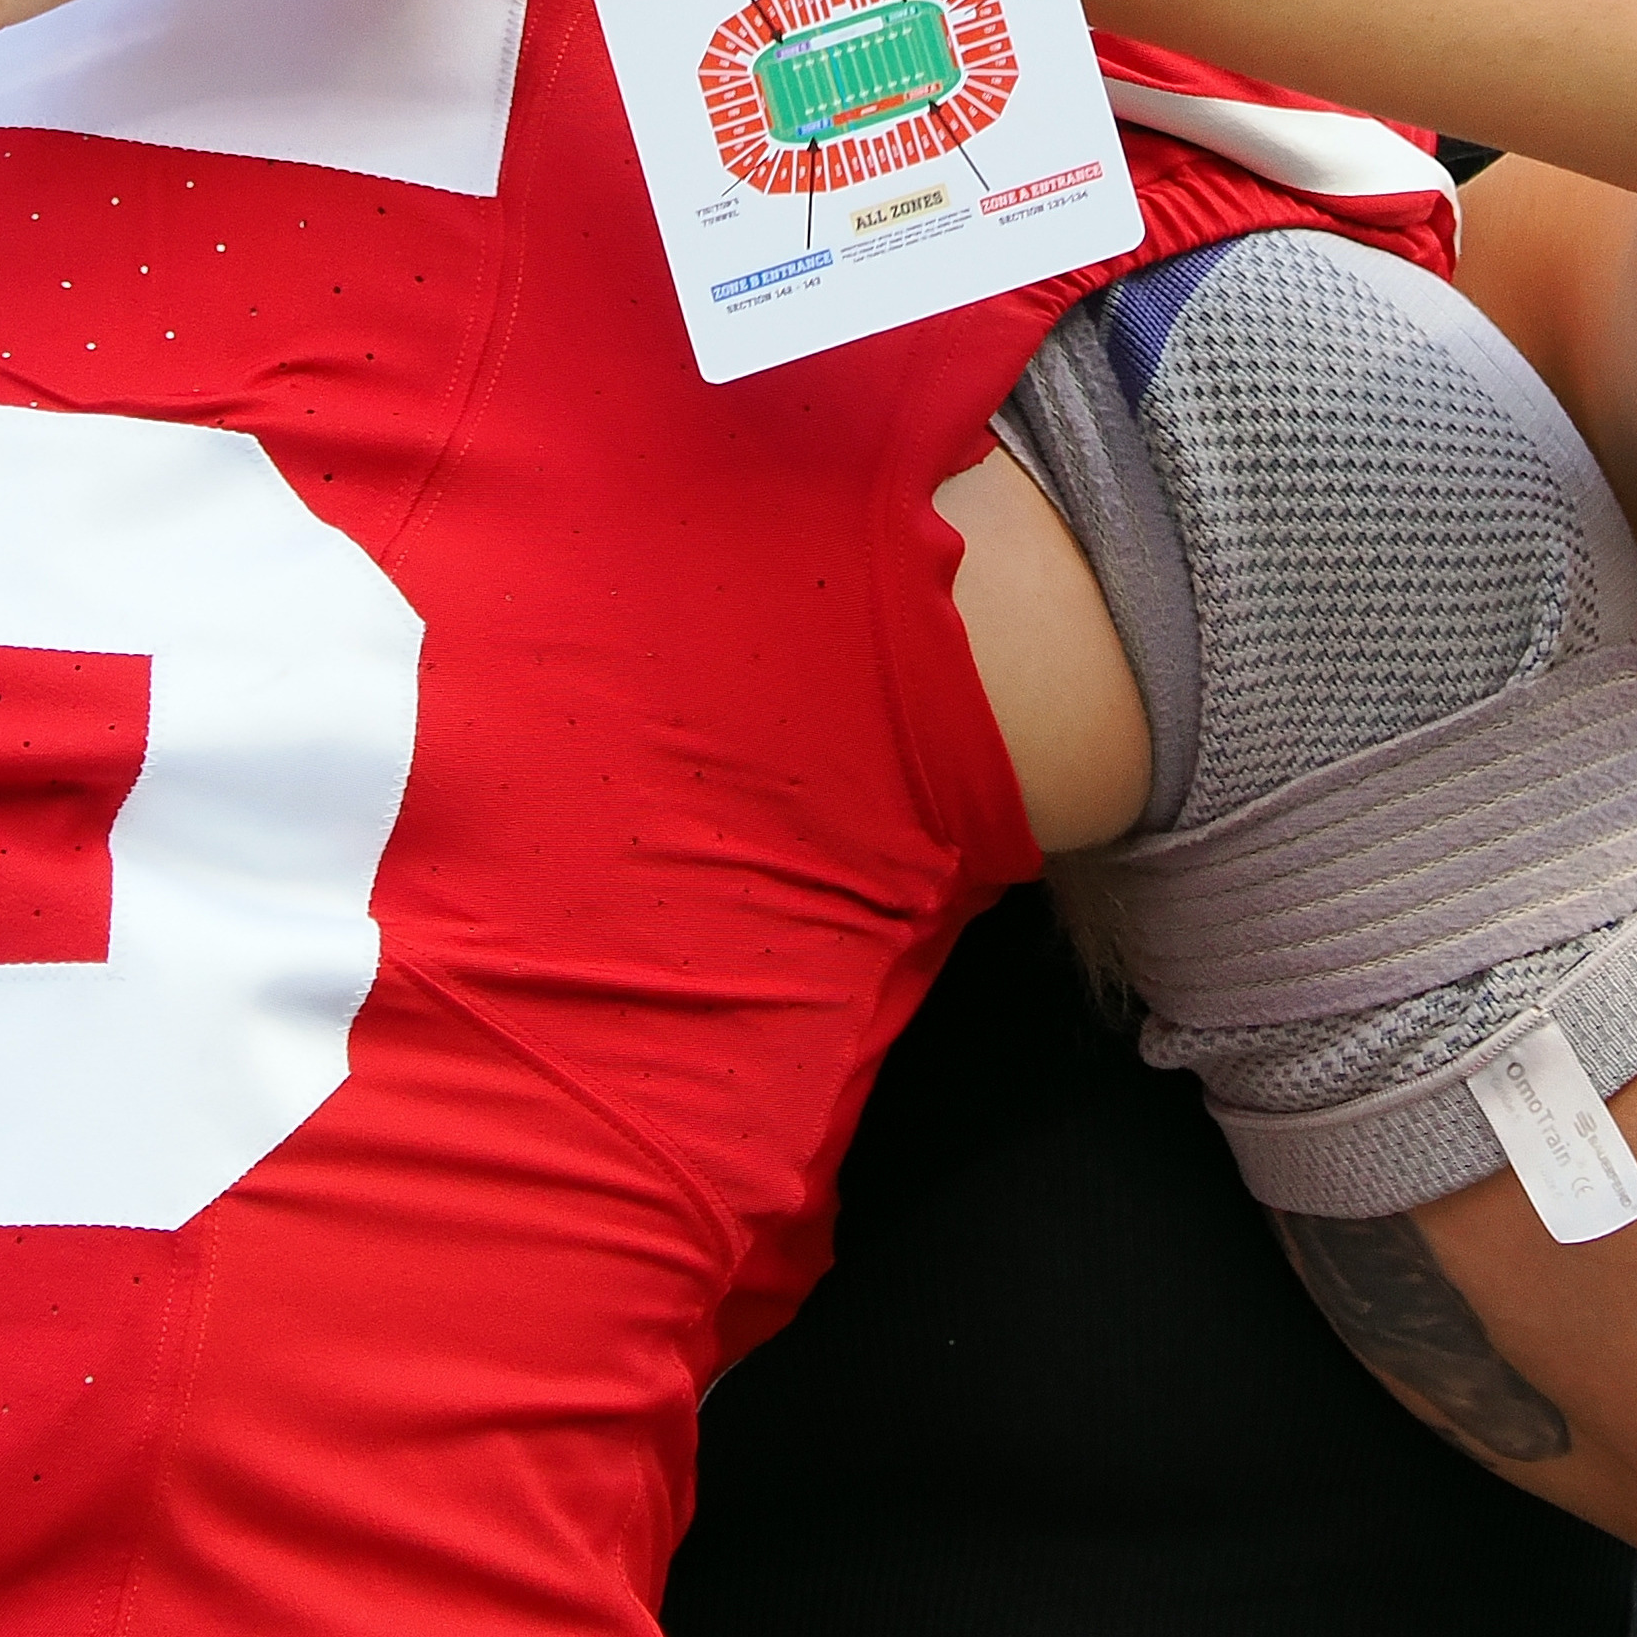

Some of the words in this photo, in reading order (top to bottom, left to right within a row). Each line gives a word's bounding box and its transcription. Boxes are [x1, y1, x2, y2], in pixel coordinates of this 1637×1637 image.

[855, 211, 887, 231] ALL
[890, 190, 943, 218] ZONES
[982, 191, 1018, 213] ZONE
[1019, 188, 1031, 202] A
[1031, 164, 1103, 198] ENTRANCE
[998, 203, 1044, 226] SECTION
[714, 276, 748, 300] ZONE
[760, 251, 832, 285] ENTRANCE
[726, 291, 772, 314] SECTION
[1506, 1061, 1572, 1168] OmoTrain
